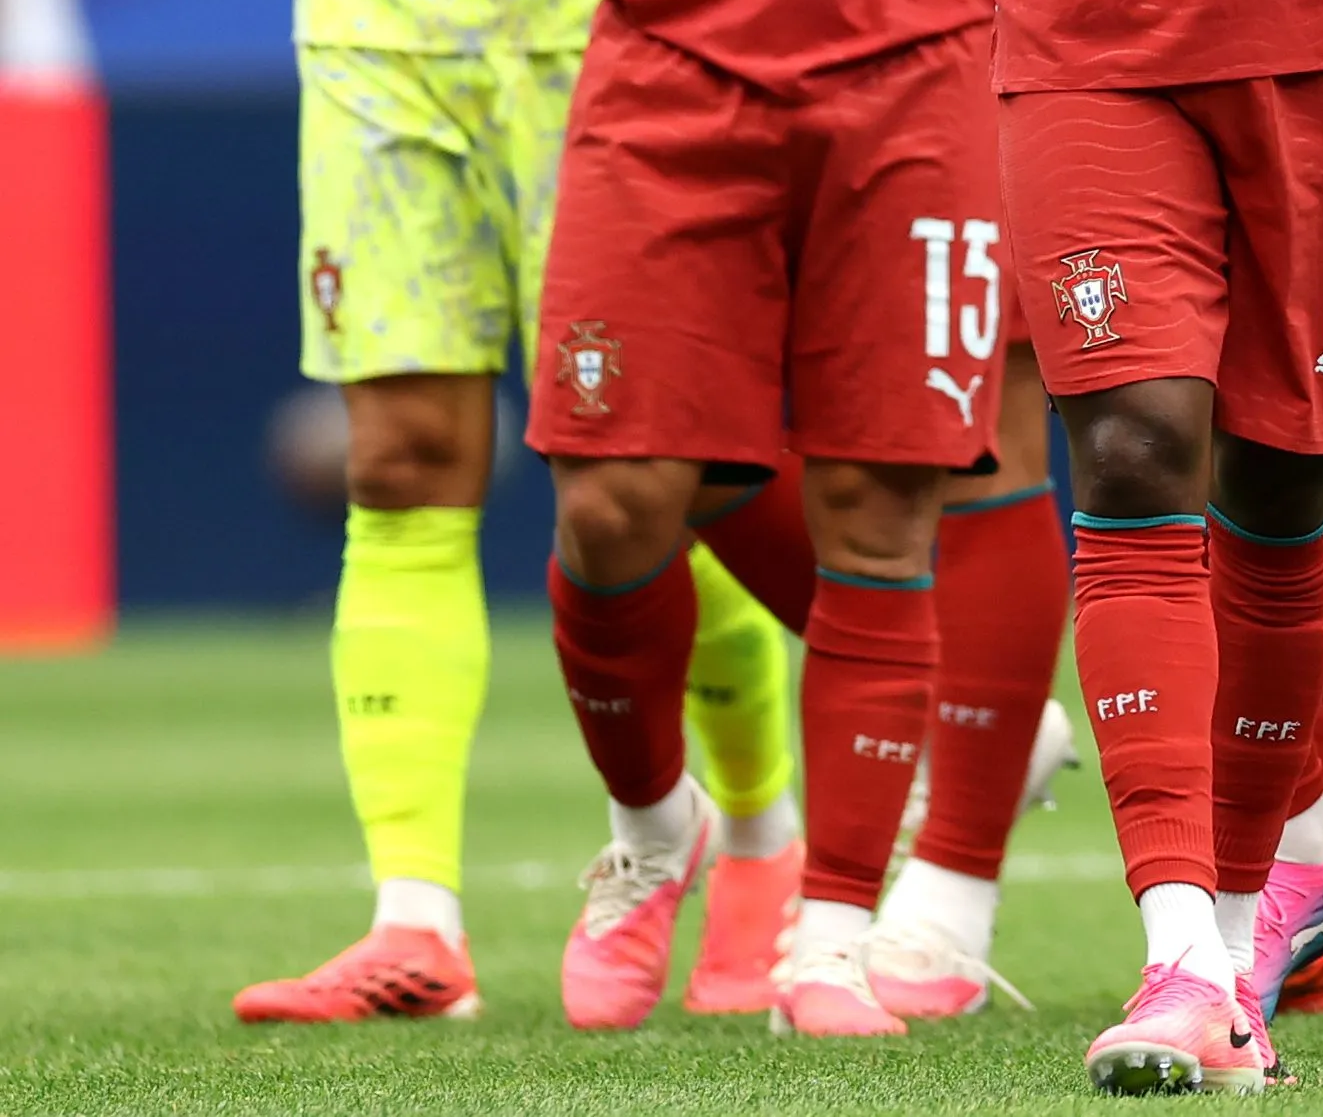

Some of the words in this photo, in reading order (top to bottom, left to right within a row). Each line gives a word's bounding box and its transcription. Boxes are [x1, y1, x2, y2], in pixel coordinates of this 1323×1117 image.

[911, 218, 998, 360] 15
[1097, 688, 1159, 720] F.P.F.
[1235, 716, 1301, 741] F.P.F.
